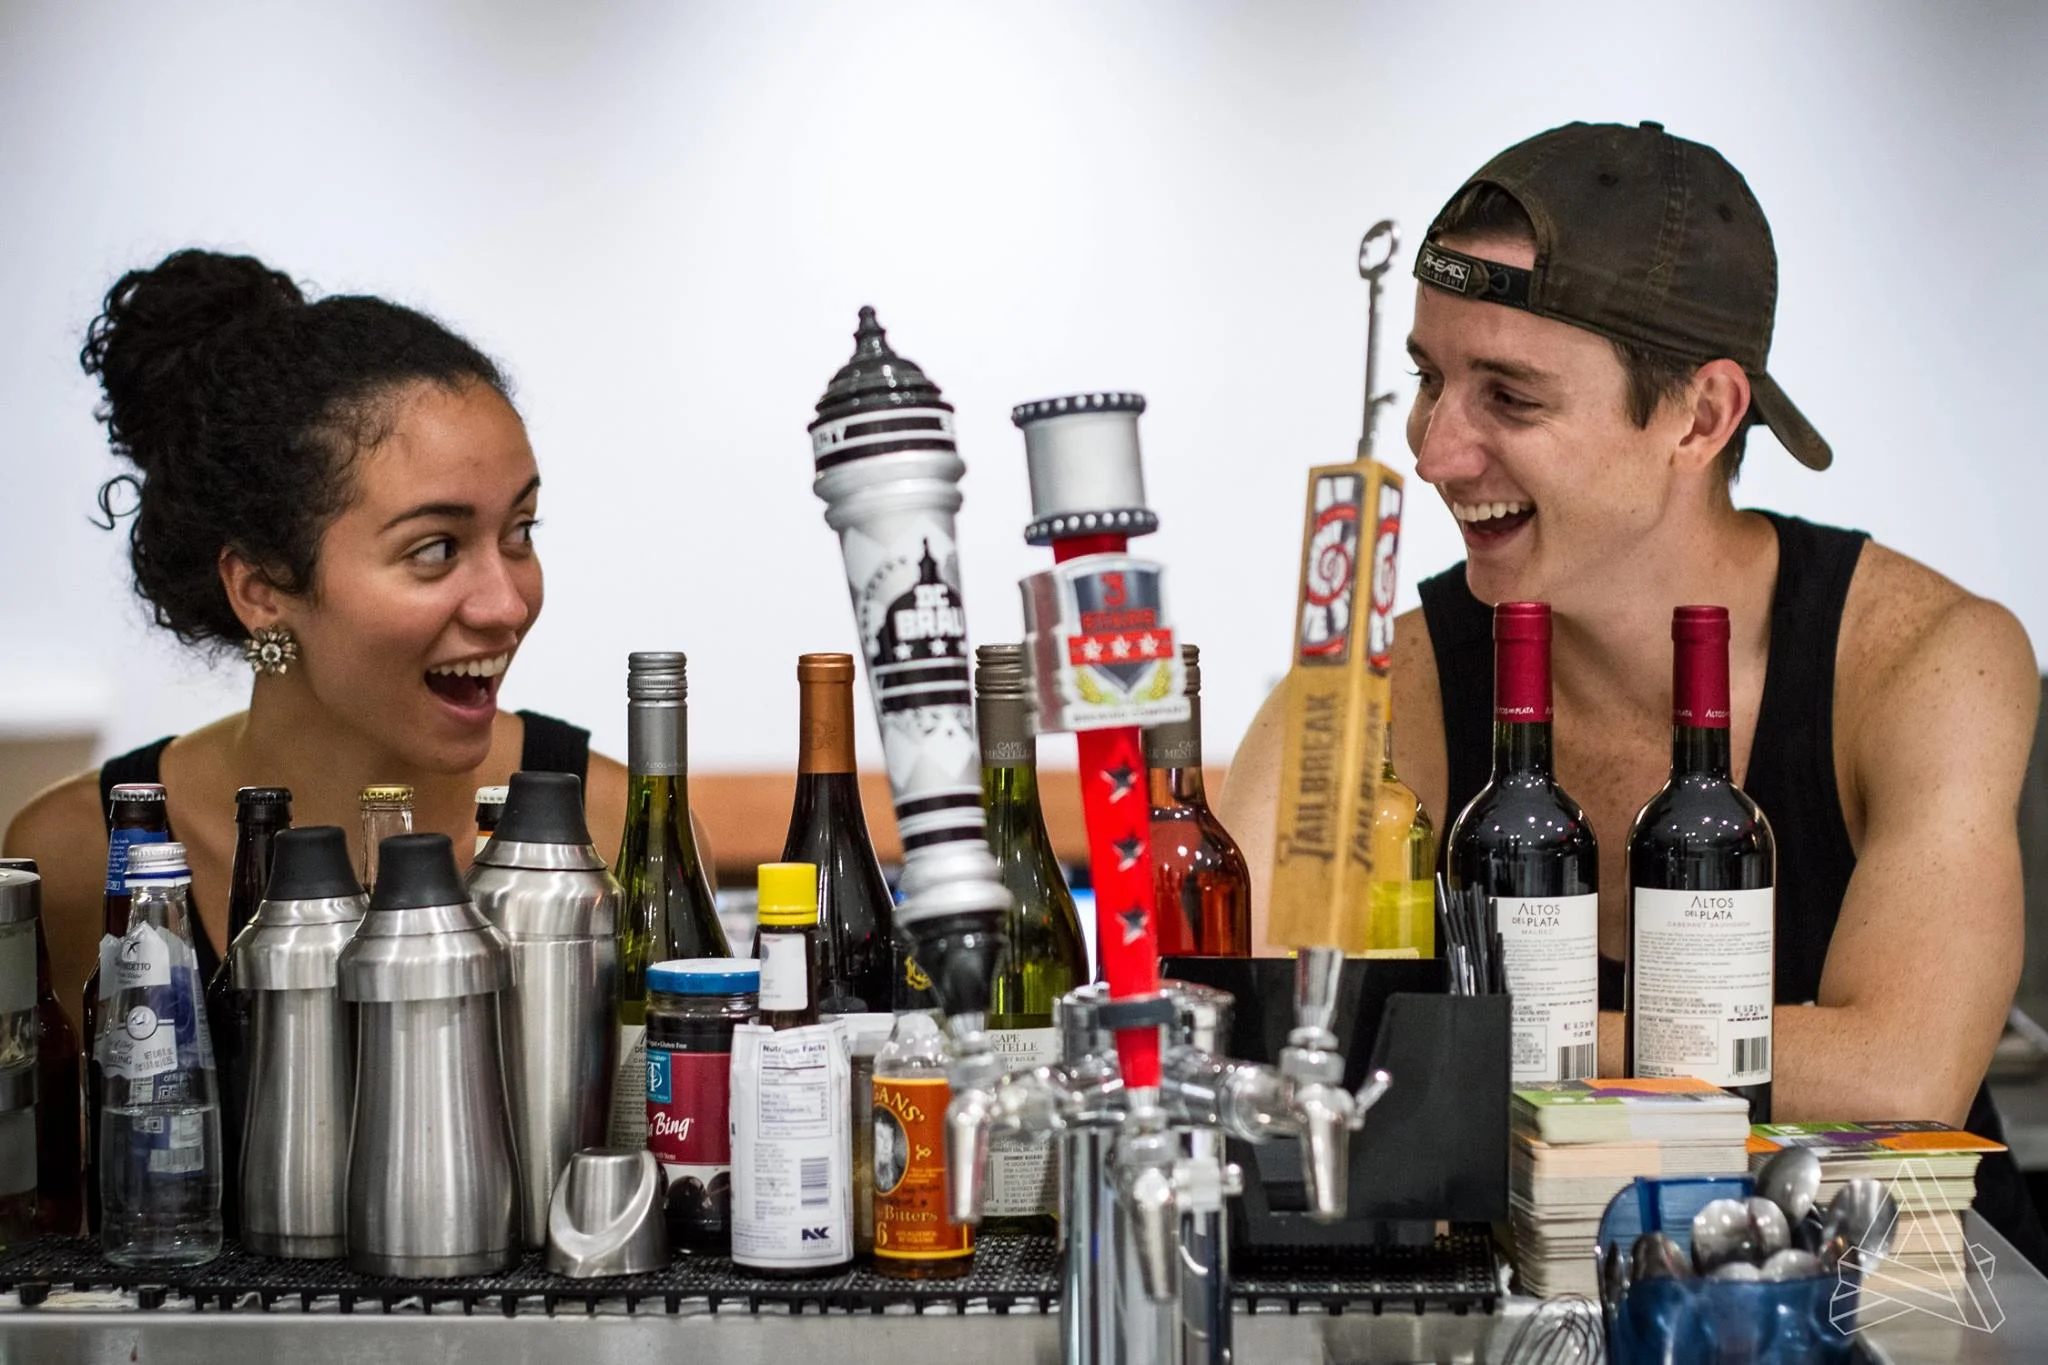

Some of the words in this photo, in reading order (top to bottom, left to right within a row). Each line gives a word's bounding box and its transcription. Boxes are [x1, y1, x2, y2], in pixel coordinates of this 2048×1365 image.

[913, 583, 950, 608] DC
[1102, 571, 1127, 607] 3
[893, 605, 965, 641] BRAU
[1518, 902, 1561, 916] ALTOS
[1684, 910, 1698, 918] DEL
[1699, 910, 1734, 920] PLATA
[1690, 896, 1734, 909] ALTOS
[1511, 916, 1526, 925] DEL
[1526, 917, 1560, 928] PLATA
[653, 1111, 691, 1141] Bing
[876, 1220, 889, 1247] 6
